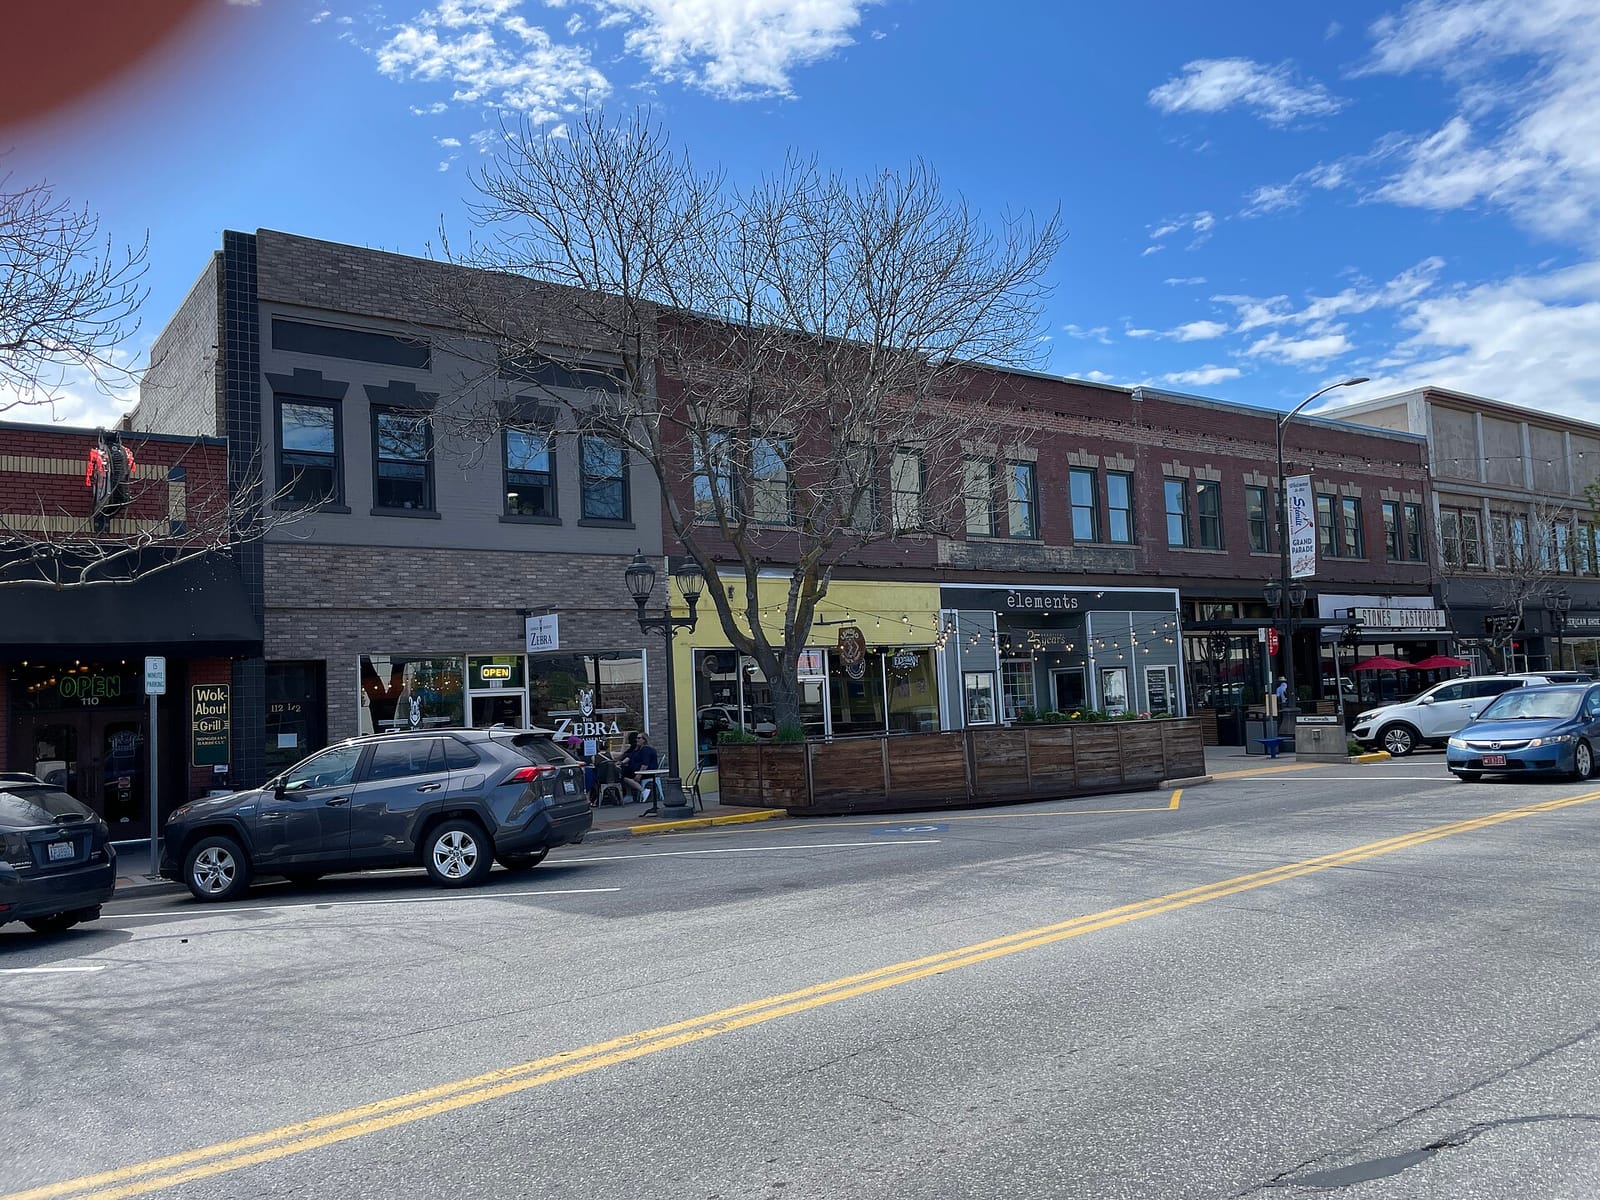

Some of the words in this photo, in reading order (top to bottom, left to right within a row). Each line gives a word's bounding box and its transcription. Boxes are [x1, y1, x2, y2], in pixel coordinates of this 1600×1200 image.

[1292, 538, 1312, 546] GRAND
[1292, 545, 1313, 554] PARADE
[1007, 592, 1078, 609] elements
[1362, 609, 1392, 626] STONES
[1399, 610, 1440, 627] GASTROPUB
[530, 632, 552, 646] ZEBRA
[483, 668, 508, 677] OPEN
[59, 675, 121, 698] OPEN
[80, 697, 99, 705] 110
[196, 688, 228, 702] Wok-
[195, 702, 226, 715] About
[271, 704, 284, 713] 112
[287, 703, 302, 713] 1/2
[199, 720, 221, 731] Grill
[551, 718, 621, 741] ZEBRA
